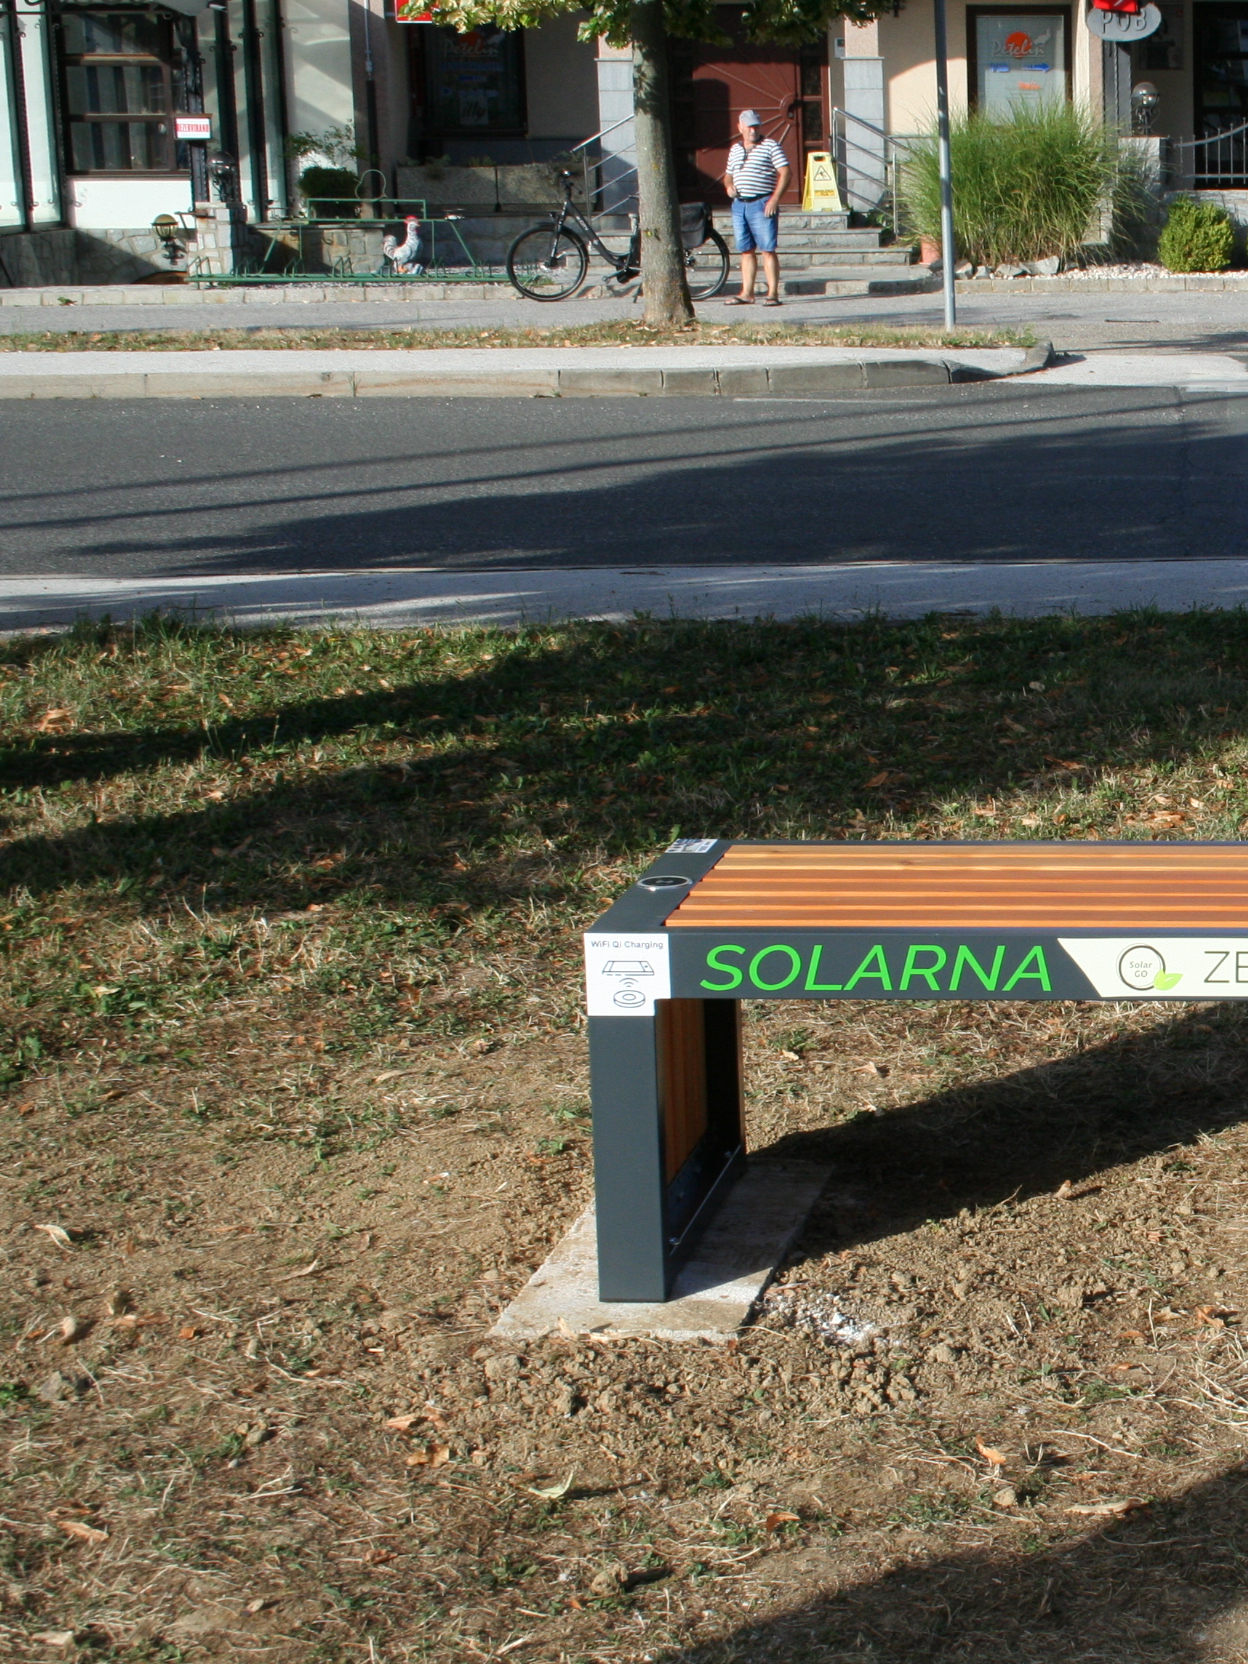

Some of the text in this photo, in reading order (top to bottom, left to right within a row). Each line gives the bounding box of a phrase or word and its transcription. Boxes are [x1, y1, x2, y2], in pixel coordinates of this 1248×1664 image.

[1102, 9, 1147, 33] PUB
[992, 38, 1045, 57] Petelin
[591, 940, 664, 950] WiFi Qi Charging
[700, 944, 1053, 991] SOLARNA
[1129, 960, 1153, 969] Solar
[1134, 970, 1148, 978] GO
